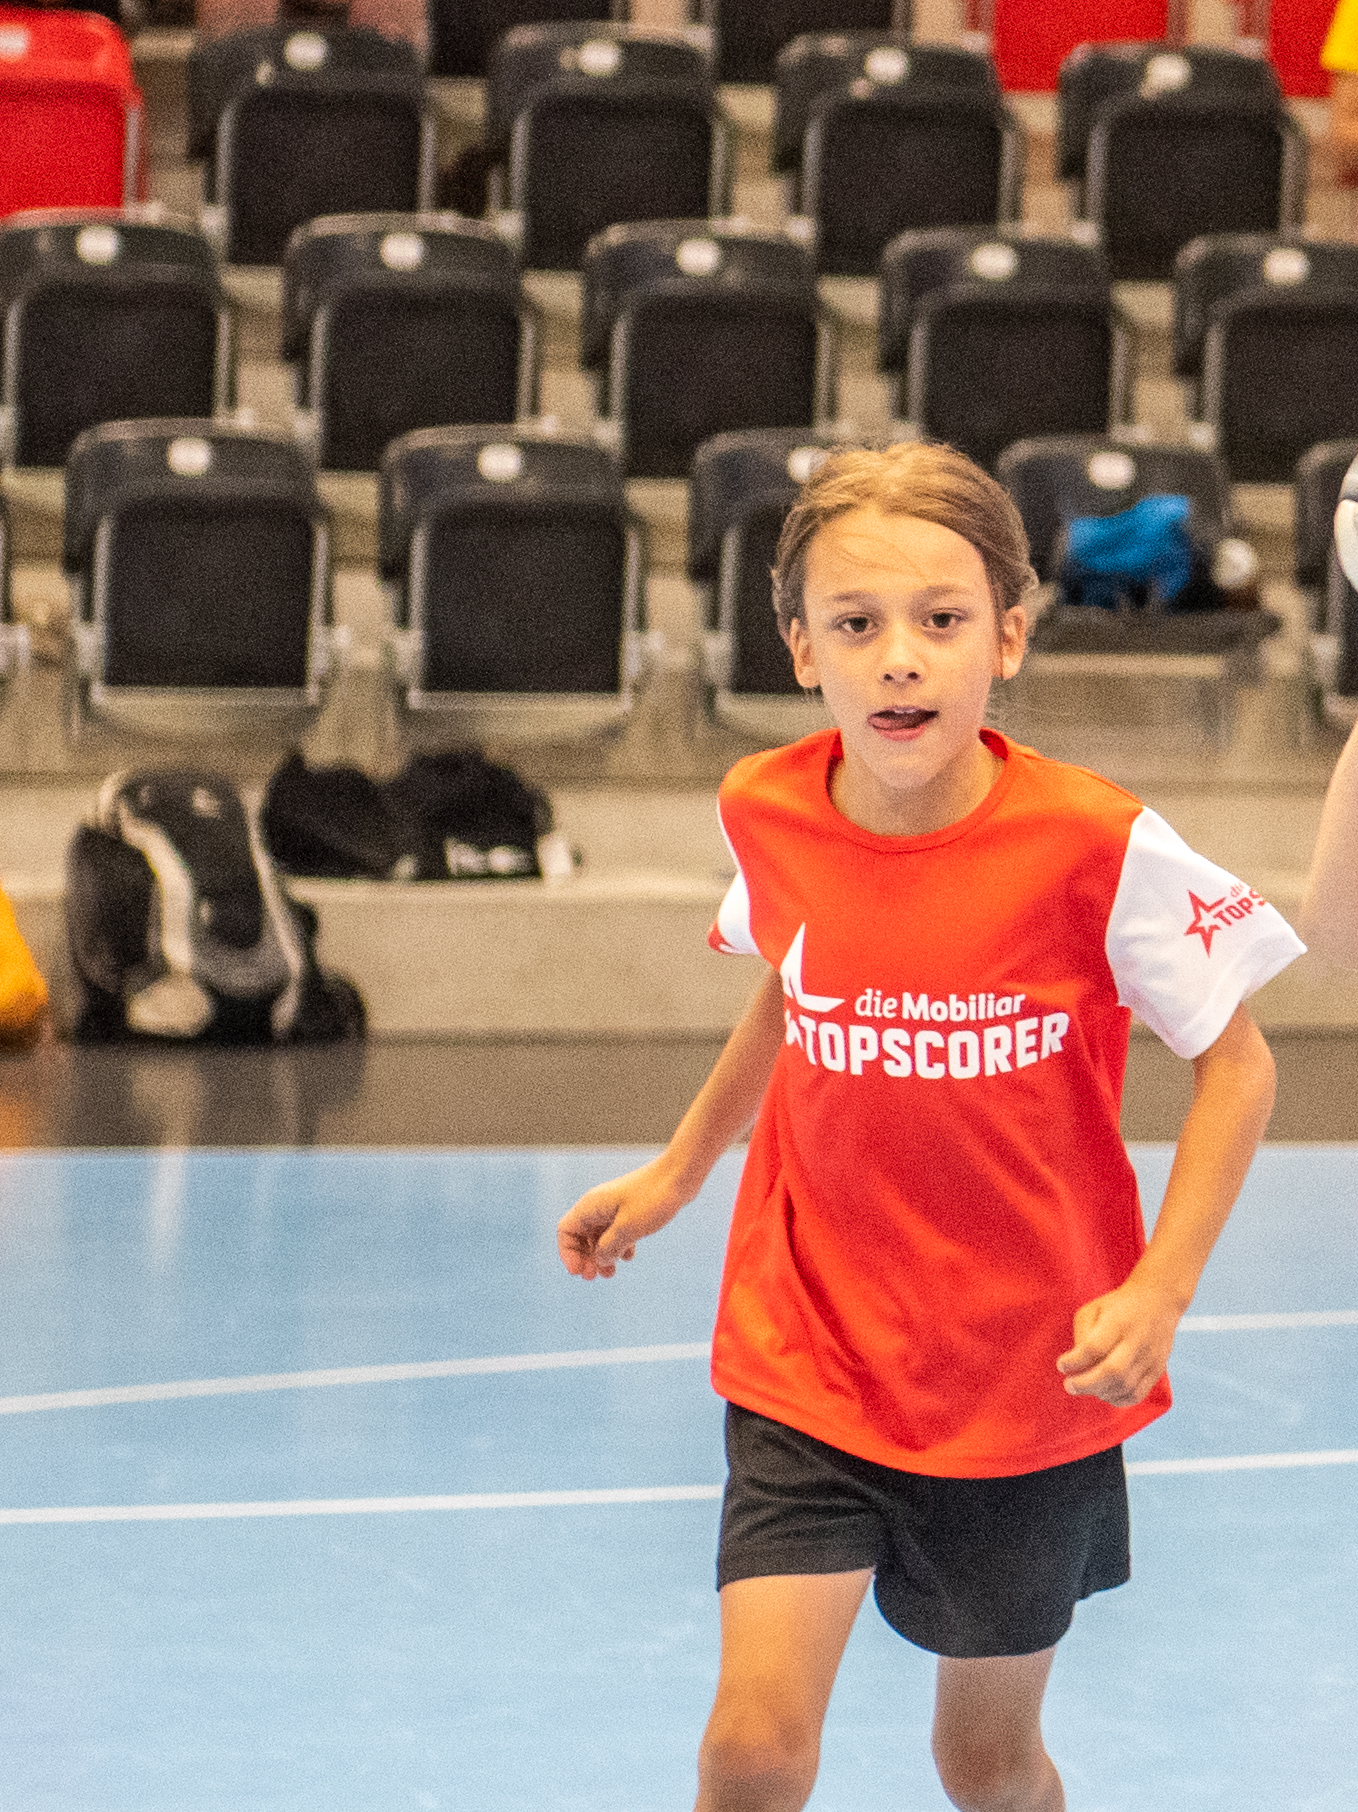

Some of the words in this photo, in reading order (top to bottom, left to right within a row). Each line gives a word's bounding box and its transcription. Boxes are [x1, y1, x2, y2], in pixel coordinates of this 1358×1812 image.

[854, 988, 898, 1018] die
[901, 992, 1026, 1022] Mobiliar
[799, 1012, 1070, 1080] TOPSCORER
